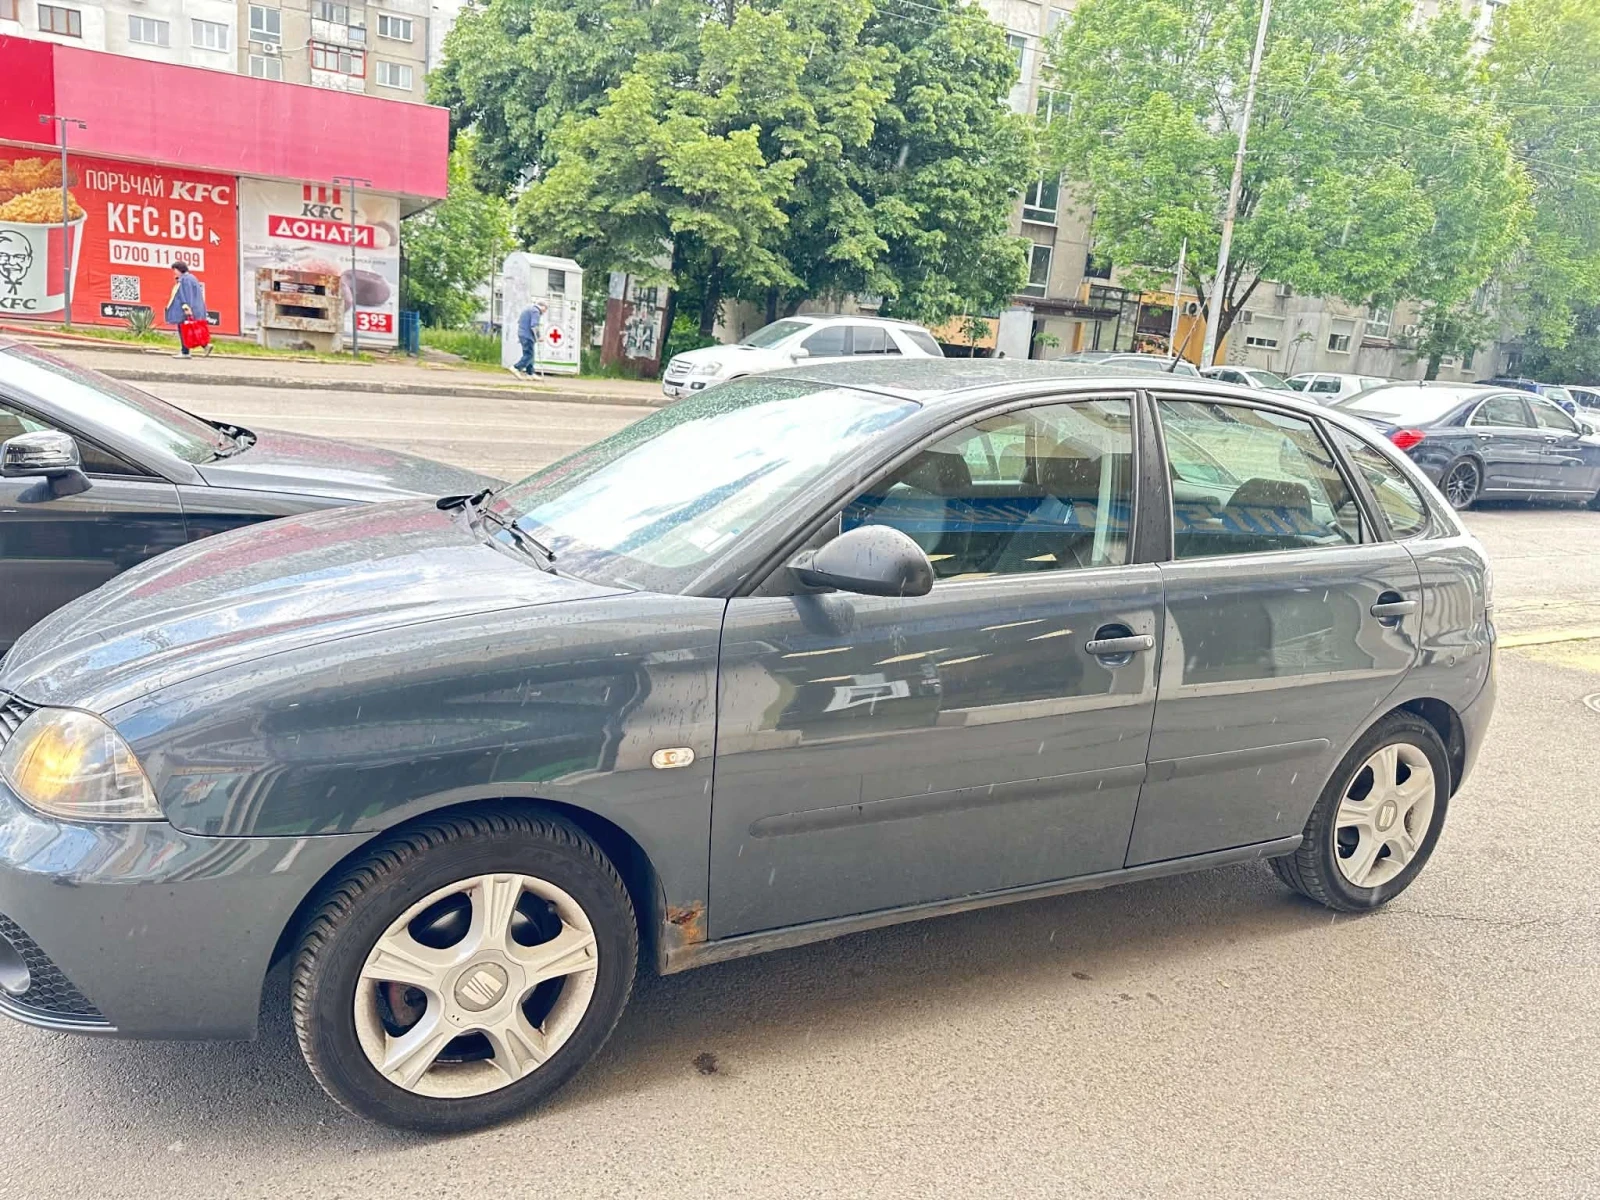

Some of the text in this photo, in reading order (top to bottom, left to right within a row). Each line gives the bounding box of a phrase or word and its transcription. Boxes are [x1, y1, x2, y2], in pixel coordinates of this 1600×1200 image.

[85, 169, 230, 205] ПОРЪЧАЙ KFC
[107, 202, 204, 242] KFC.BG
[301, 202, 344, 221] KFC
[275, 218, 369, 246] ДОНАТИ
[113, 244, 150, 263] 0700
[155, 248, 170, 265] 11
